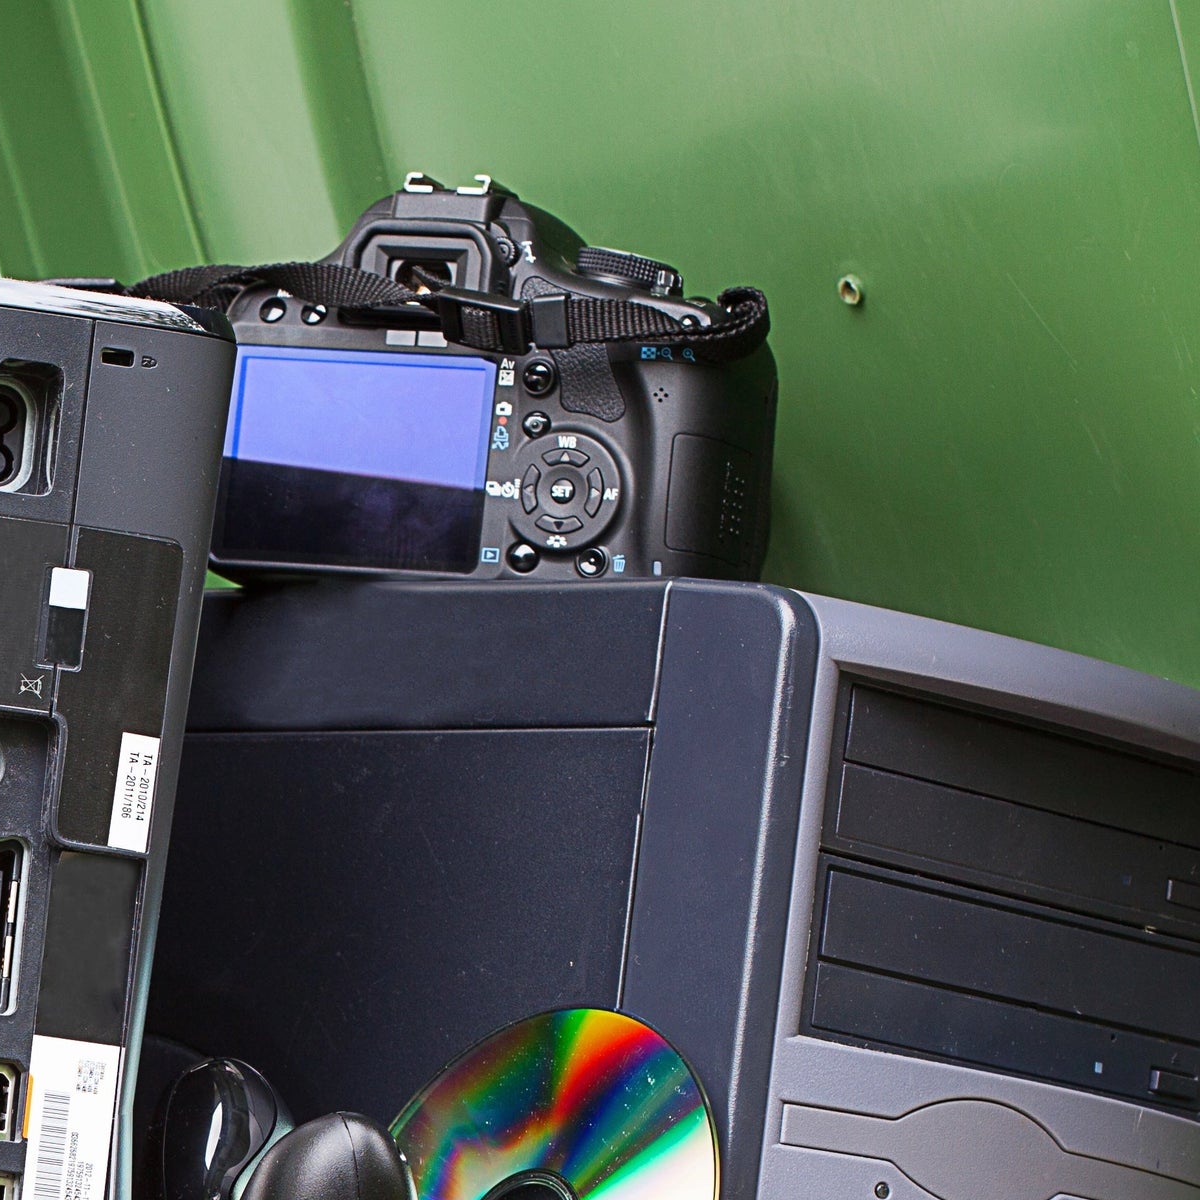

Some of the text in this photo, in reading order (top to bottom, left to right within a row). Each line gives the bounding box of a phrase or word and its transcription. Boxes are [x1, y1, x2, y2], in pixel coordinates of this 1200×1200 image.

[500, 357, 515, 369] Av
[557, 435, 576, 447] WB
[551, 485, 572, 497] SET
[603, 488, 618, 500] AF
